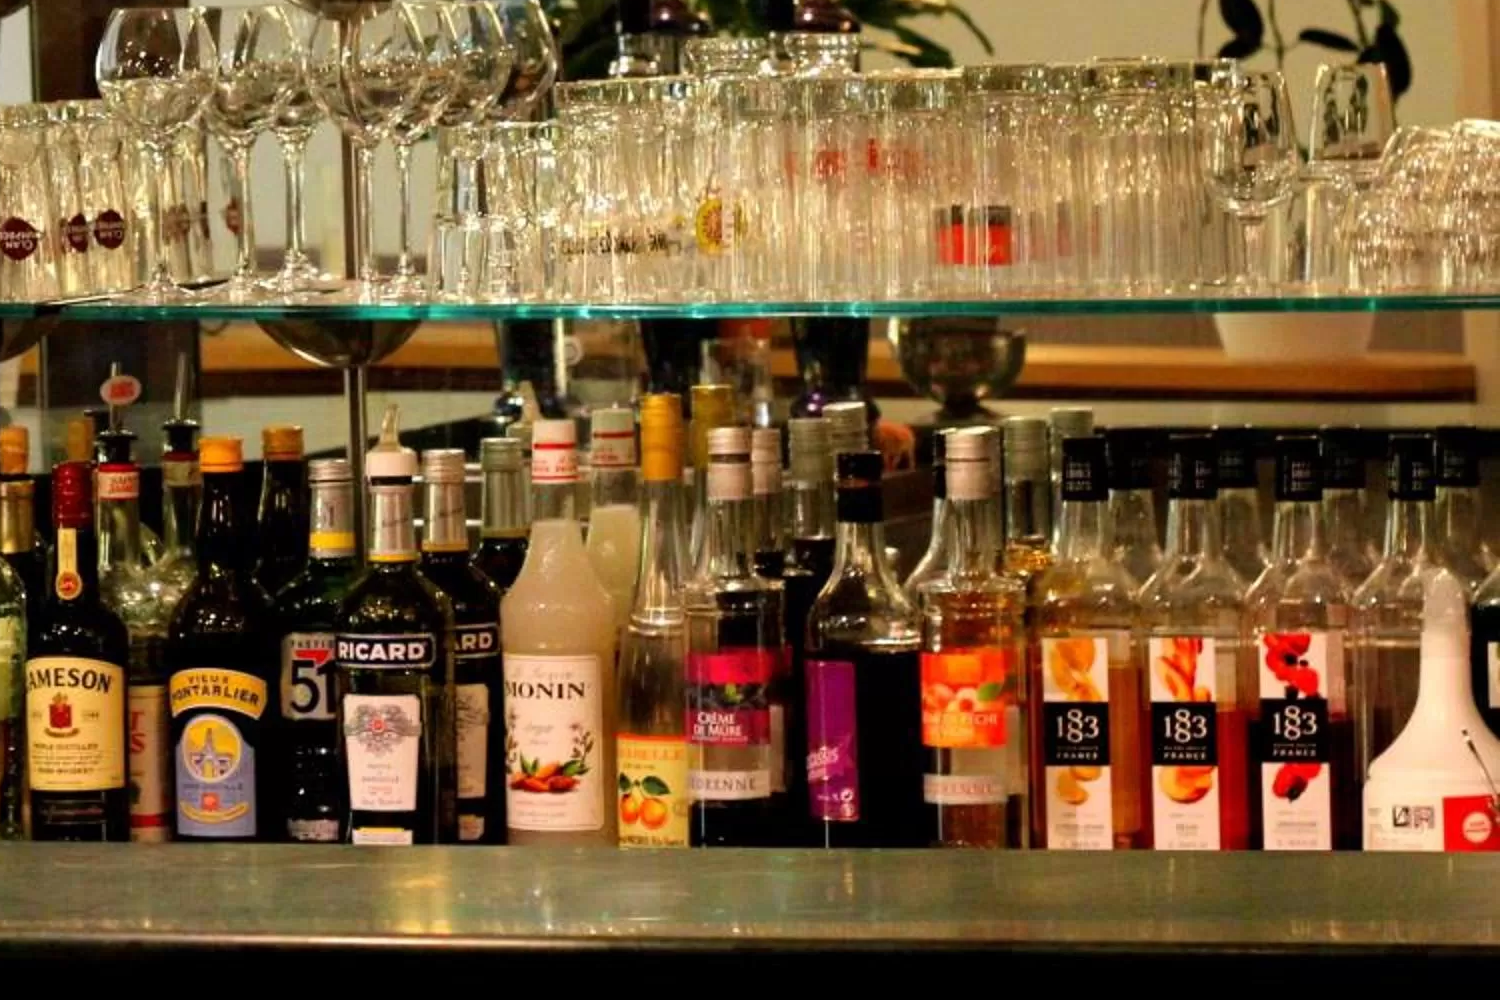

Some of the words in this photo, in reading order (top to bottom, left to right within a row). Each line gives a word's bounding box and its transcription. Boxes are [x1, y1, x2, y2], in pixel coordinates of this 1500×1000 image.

[338, 641, 425, 661] RICARD
[28, 667, 112, 694] AMESON
[290, 660, 336, 713] 51
[505, 682, 585, 699] MONIN
